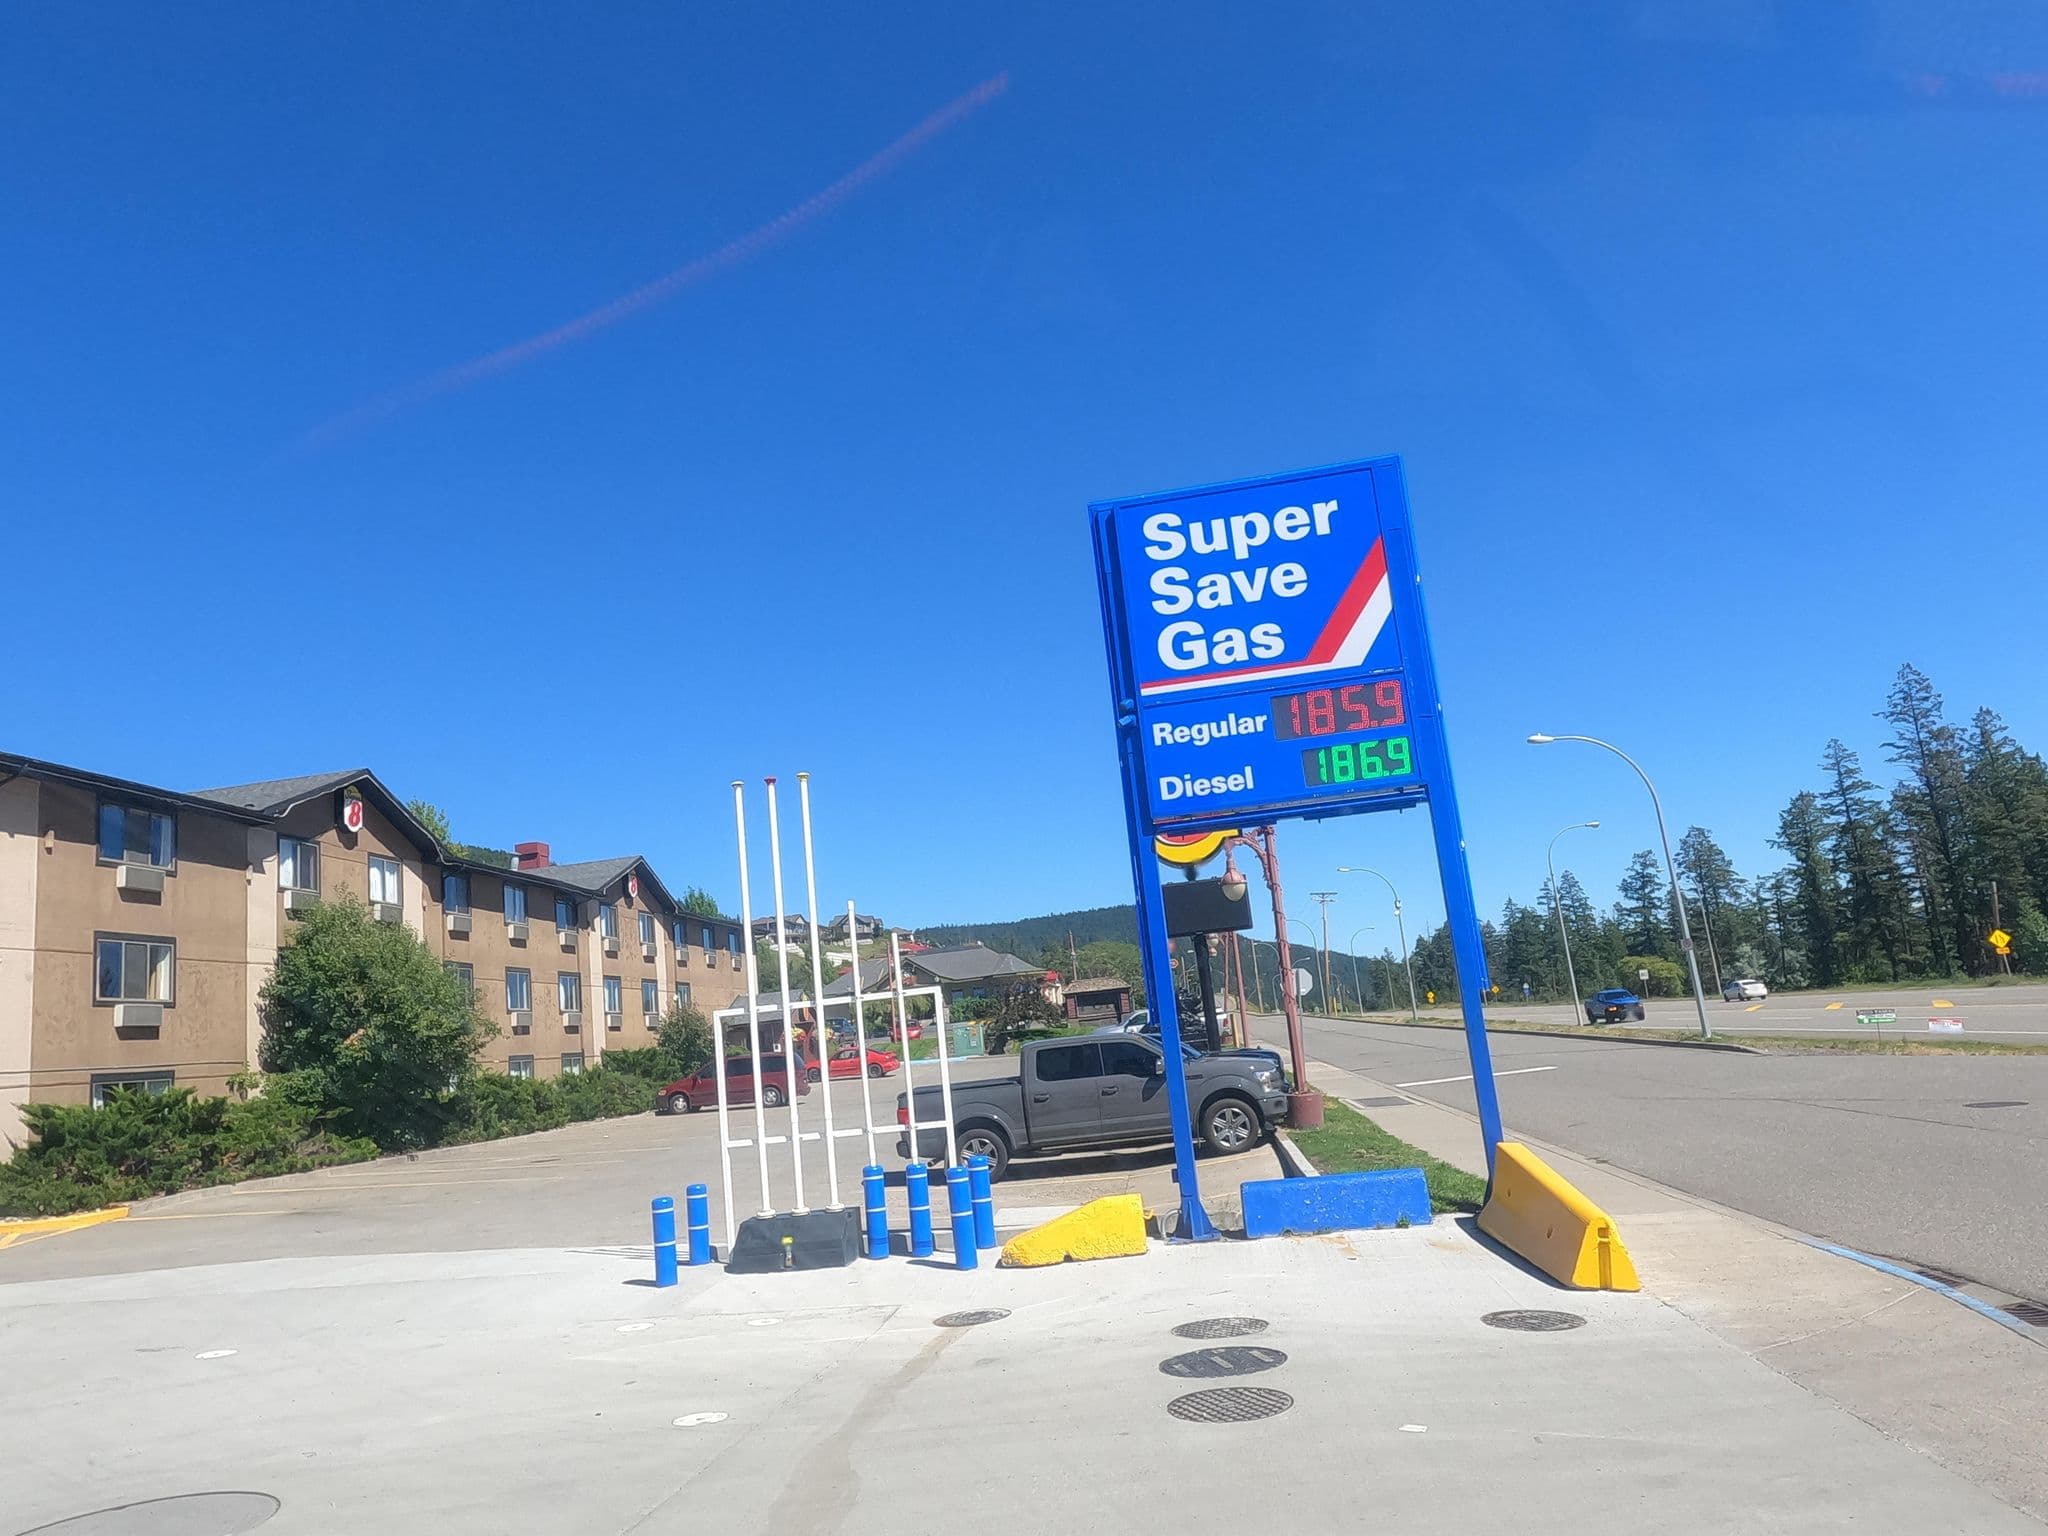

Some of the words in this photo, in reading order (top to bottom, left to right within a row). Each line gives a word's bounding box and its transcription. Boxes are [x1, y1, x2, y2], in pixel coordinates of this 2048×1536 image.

[1143, 499, 1339, 560] Super
[1150, 562, 1308, 615] Save
[1157, 621, 1286, 671] Gas
[1152, 713, 1268, 746] Regular
[1290, 679, 1406, 736] 185.9
[1159, 765, 1254, 801] Diesel
[1318, 736, 1412, 783] 186.9
[348, 802, 361, 827] 8
